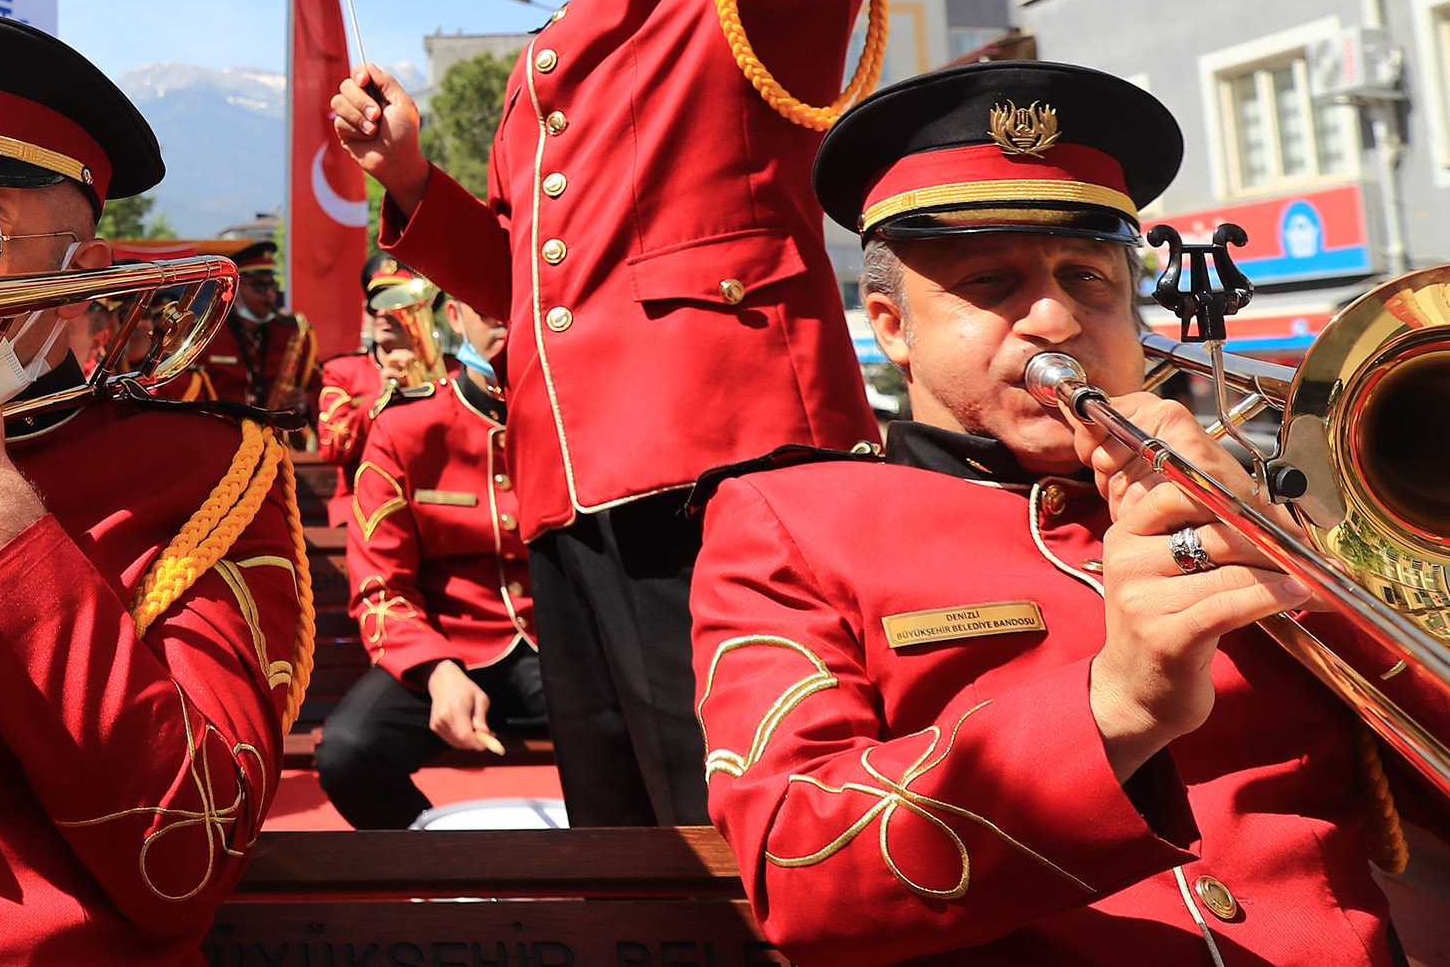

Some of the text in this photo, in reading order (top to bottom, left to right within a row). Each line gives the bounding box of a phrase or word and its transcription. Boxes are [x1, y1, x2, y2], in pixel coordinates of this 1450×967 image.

[946, 610, 980, 622] DENİZLİ
[896, 617, 1036, 640] BÜYÜKŞEHİR BELEDİYE BANDOSU
[615, 940, 783, 967] BELE
